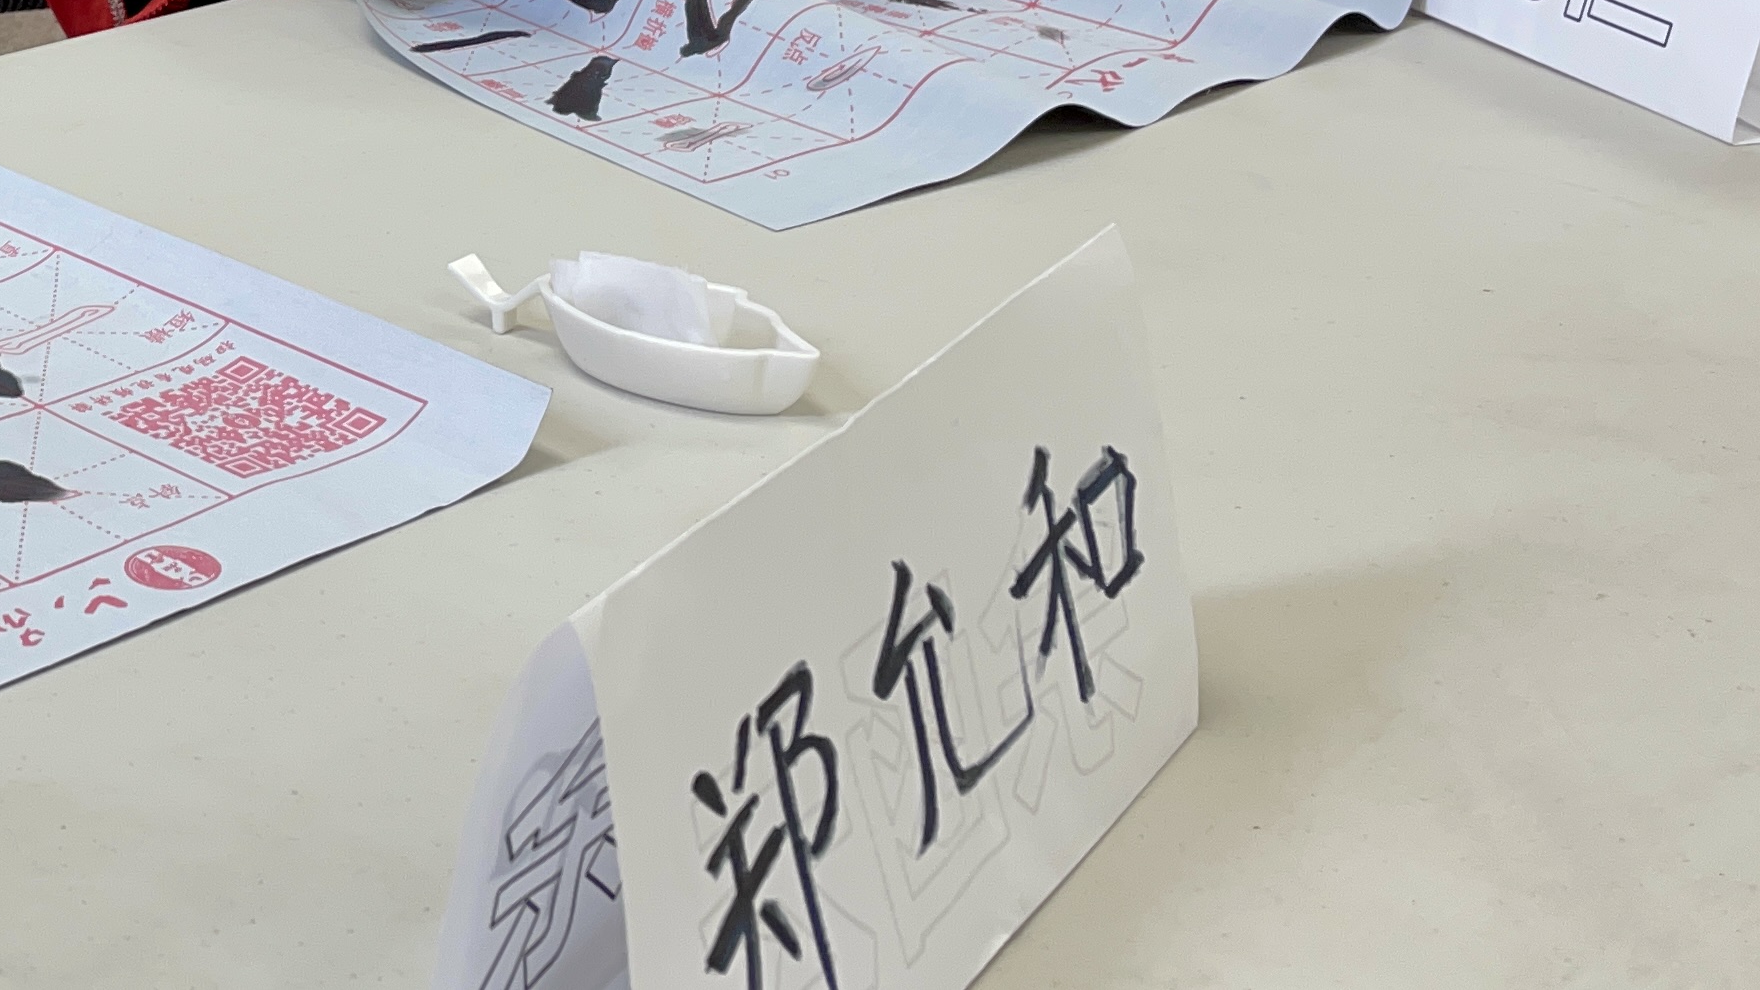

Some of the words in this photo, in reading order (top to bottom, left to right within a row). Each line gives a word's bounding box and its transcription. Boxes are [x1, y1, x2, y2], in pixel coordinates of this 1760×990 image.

[631, 0, 675, 50] 横折撇
[781, 27, 824, 68] 反点
[142, 311, 195, 344] 短横
[72, 341, 233, 413] 扫码观看视频讲解
[128, 485, 179, 508] 斜点
